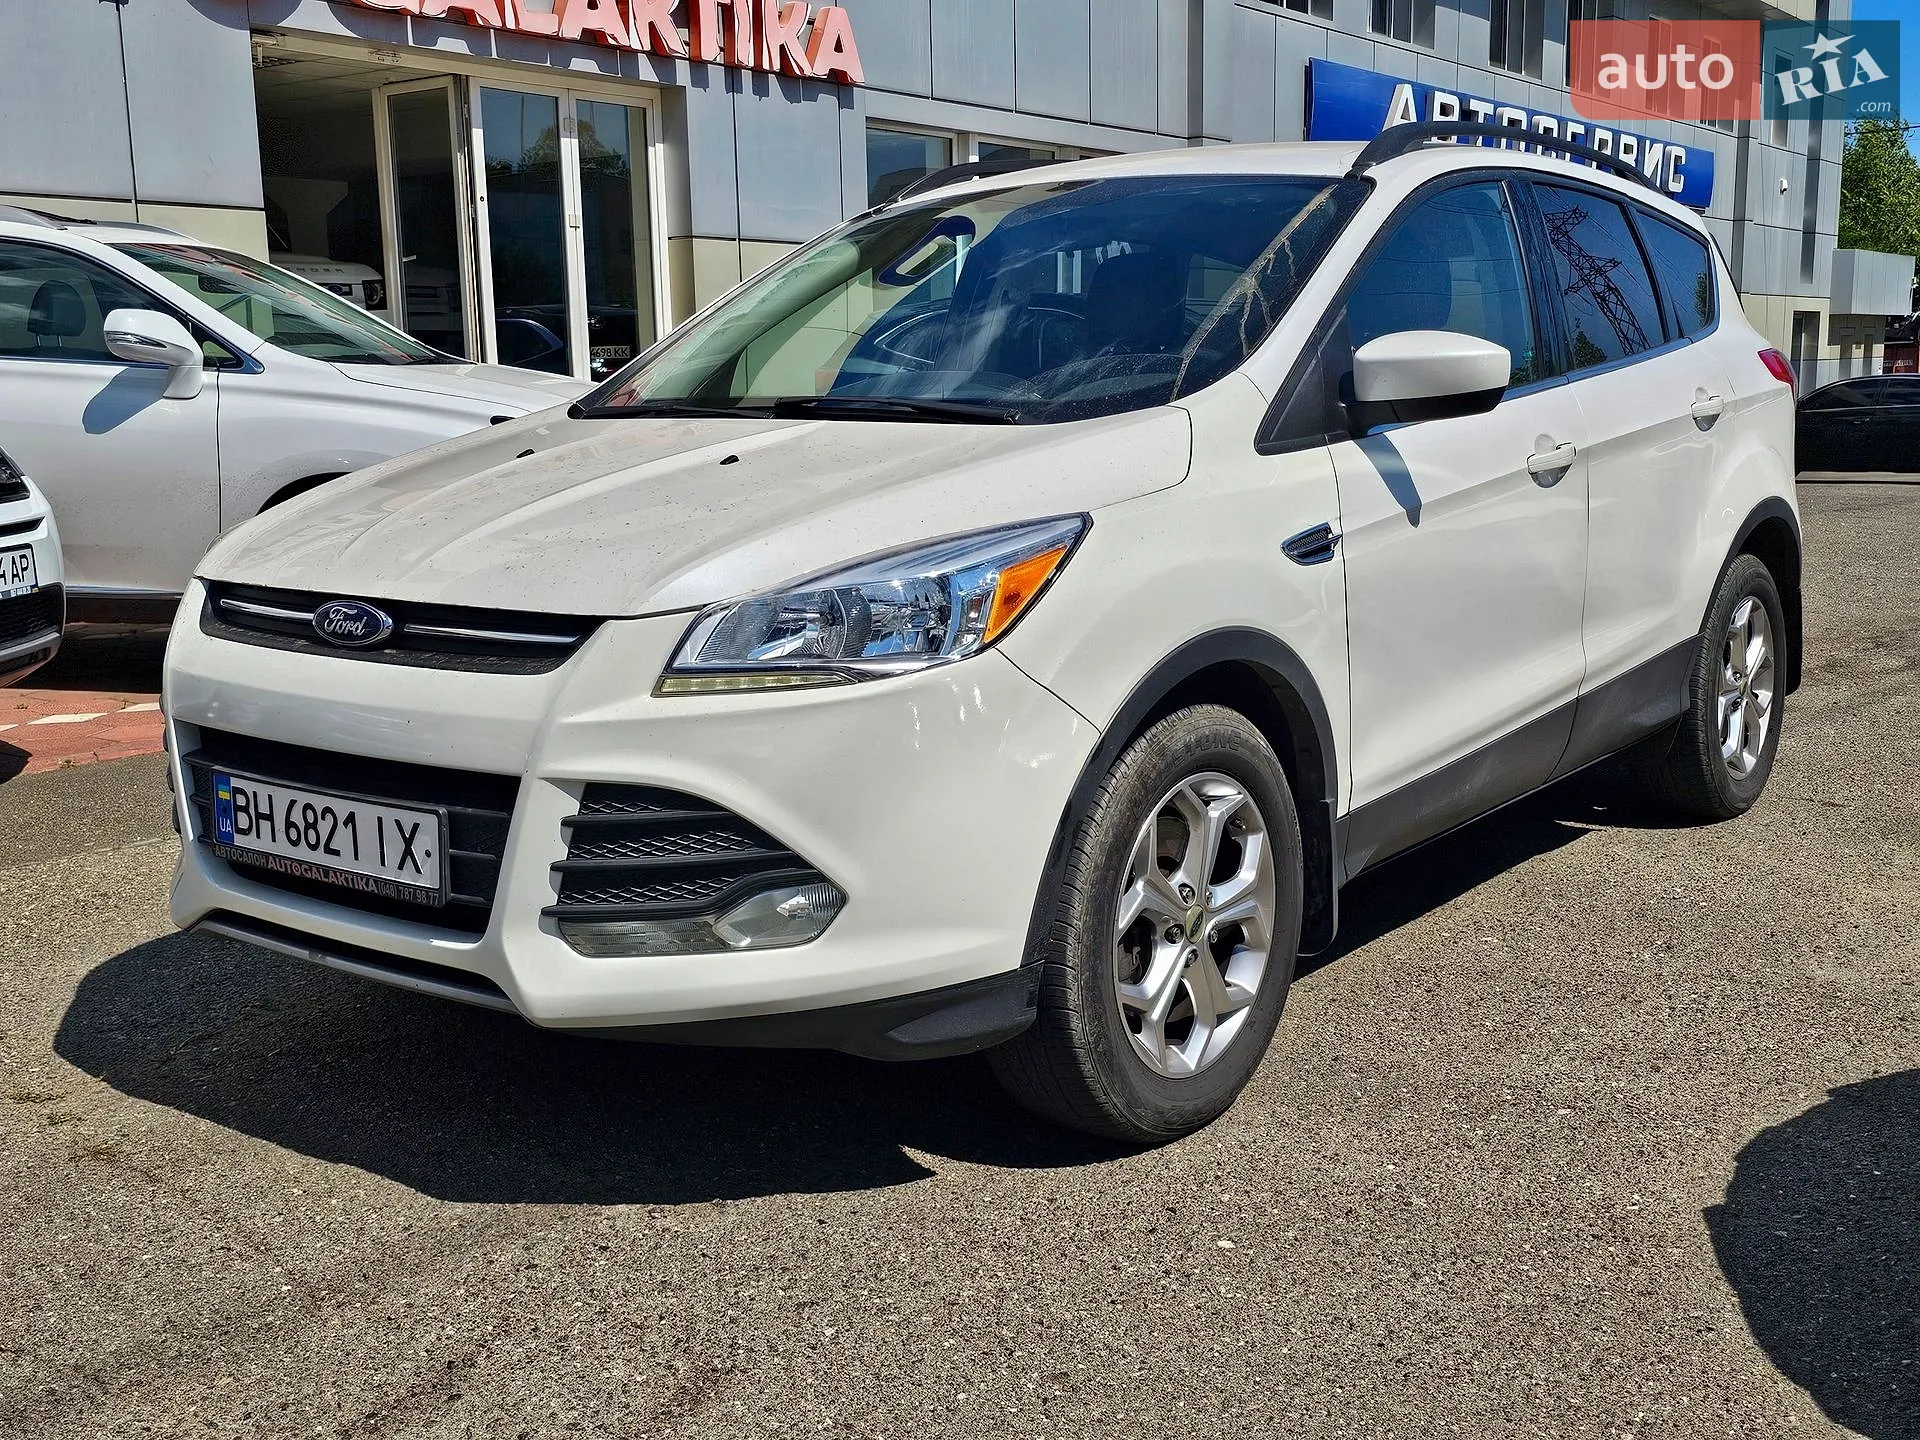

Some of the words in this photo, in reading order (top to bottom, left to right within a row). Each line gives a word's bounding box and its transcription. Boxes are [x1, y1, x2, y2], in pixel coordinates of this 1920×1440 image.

[613, 347, 630, 358] KK
[11, 553, 29, 585] AP
[324, 606, 368, 636] Ford
[219, 817, 233, 834] UA
[231, 785, 277, 843] BH
[284, 799, 360, 861] 6821
[376, 815, 424, 875] IX
[215, 844, 267, 868] АВТОСАЛОН
[267, 855, 378, 893] AUTOGALAKTIKA
[399, 886, 414, 901] 787
[416, 890, 427, 904] 98
[428, 892, 439, 906] 77
